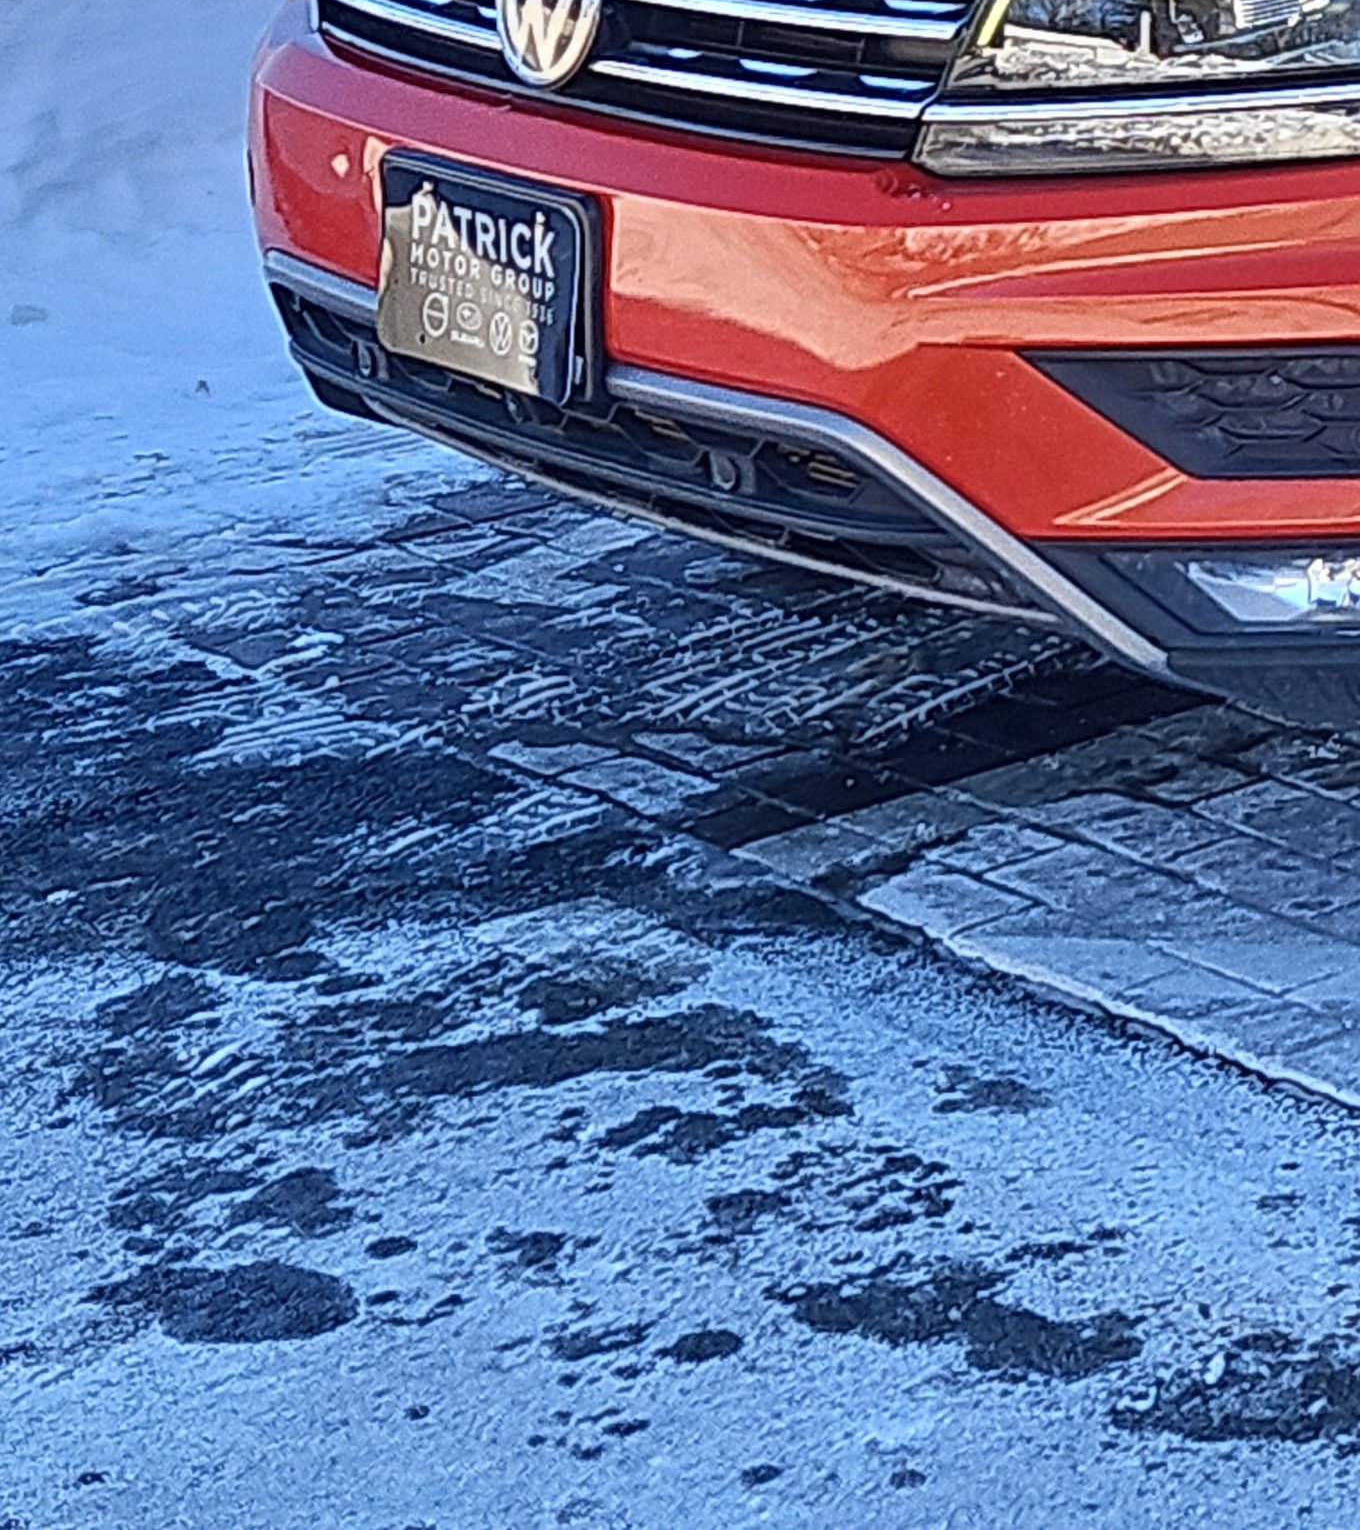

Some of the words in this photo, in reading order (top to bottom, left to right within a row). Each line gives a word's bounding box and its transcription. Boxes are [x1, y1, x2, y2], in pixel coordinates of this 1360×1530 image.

[411, 192, 556, 278] PATRICK
[410, 242, 481, 280] MOTOR
[490, 264, 556, 302] GROUP
[410, 267, 473, 299] TRUSTED
